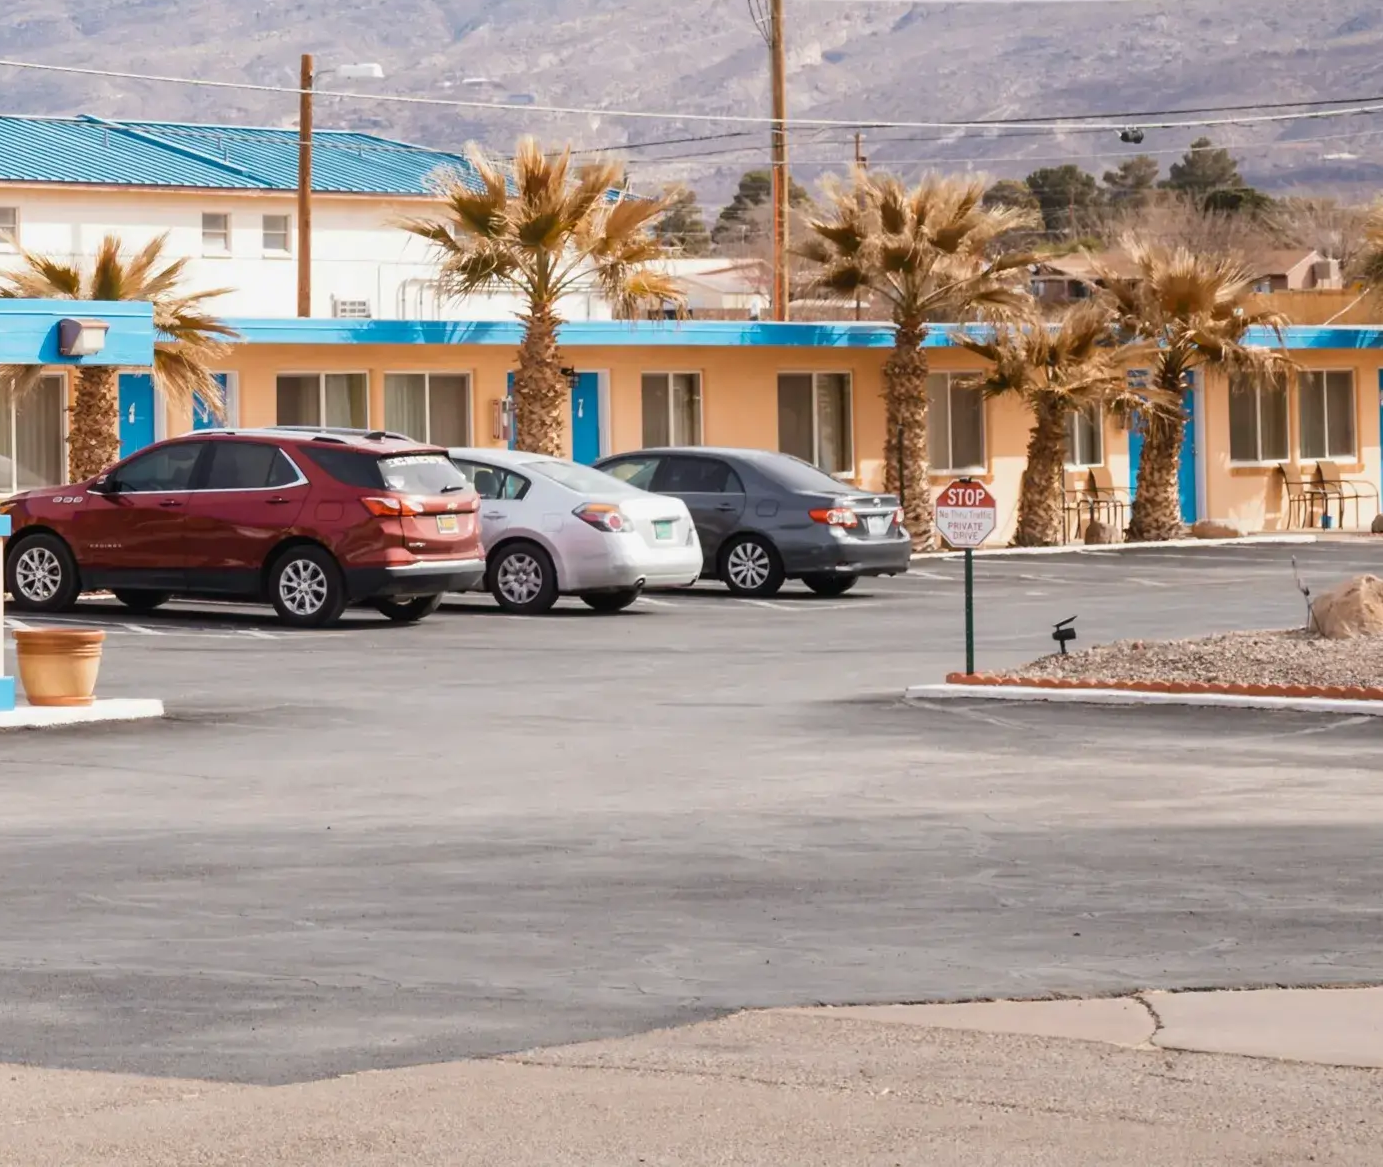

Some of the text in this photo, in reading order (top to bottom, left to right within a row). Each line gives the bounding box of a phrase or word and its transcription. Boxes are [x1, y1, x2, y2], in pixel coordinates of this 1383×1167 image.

[947, 488, 985, 505] STOP
[948, 522, 983, 530] PRIVATE
[953, 532, 978, 540] DRIVE
